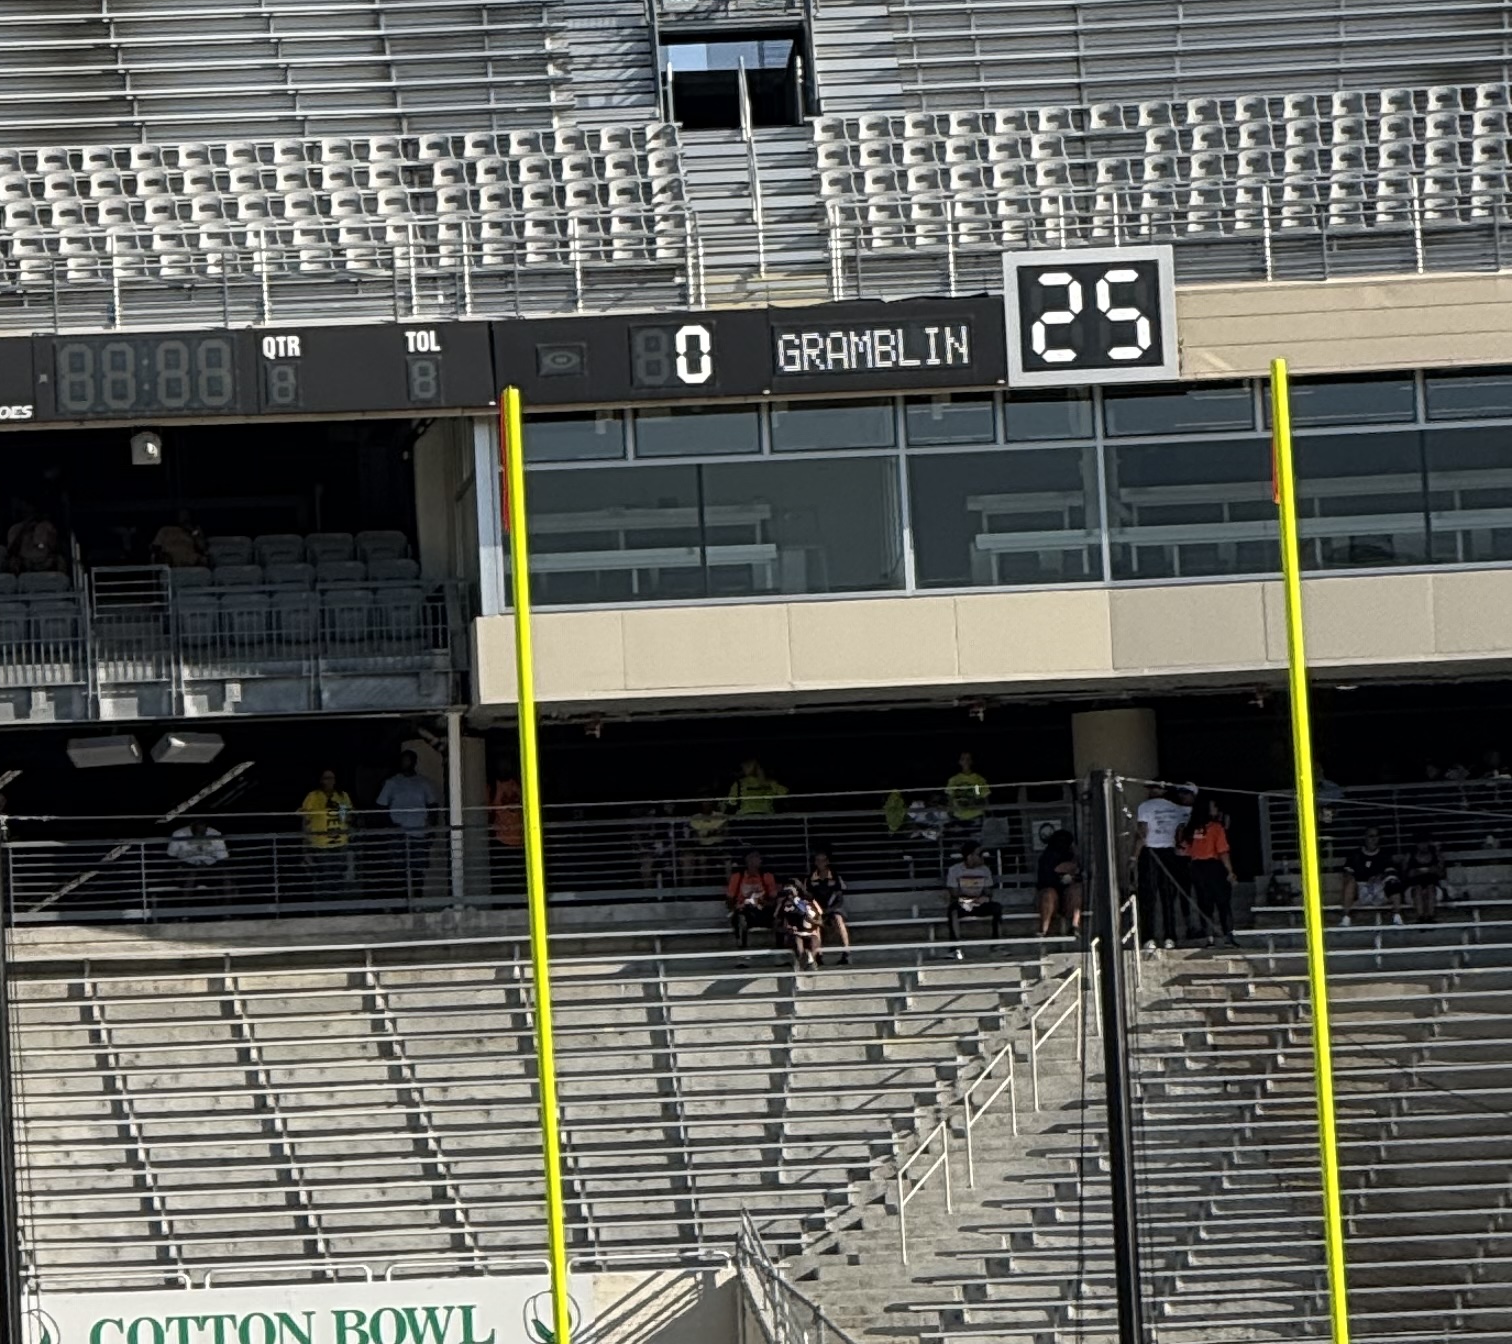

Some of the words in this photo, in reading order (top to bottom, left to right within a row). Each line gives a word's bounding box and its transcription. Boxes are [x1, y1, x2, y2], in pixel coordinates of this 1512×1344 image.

[1029, 268, 1153, 365] 25
[262, 334, 302, 361] QTR
[405, 329, 441, 355] TOL
[674, 324, 713, 385] 0
[776, 324, 972, 373] GRAMBLIN
[89, 1311, 315, 1344] COTTON
[331, 1305, 496, 1344] BOWL
